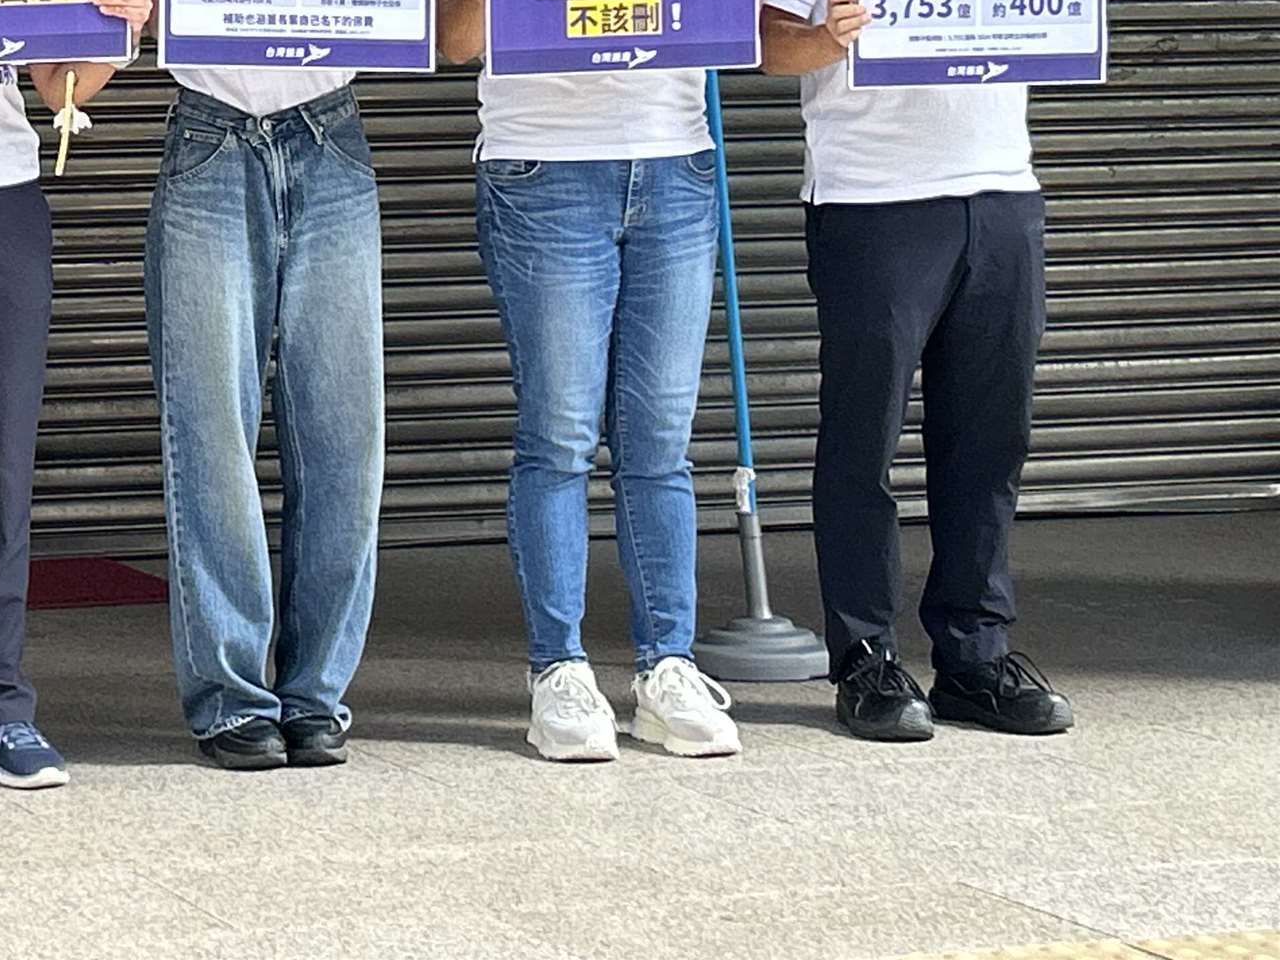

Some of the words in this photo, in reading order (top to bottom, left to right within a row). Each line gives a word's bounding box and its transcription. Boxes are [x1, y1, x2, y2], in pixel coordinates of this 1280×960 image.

[957, 3, 972, 18] 億
[992, 3, 1007, 18] 約
[1067, 1, 1082, 16] 億
[569, 2, 683, 36] 不該刪！
